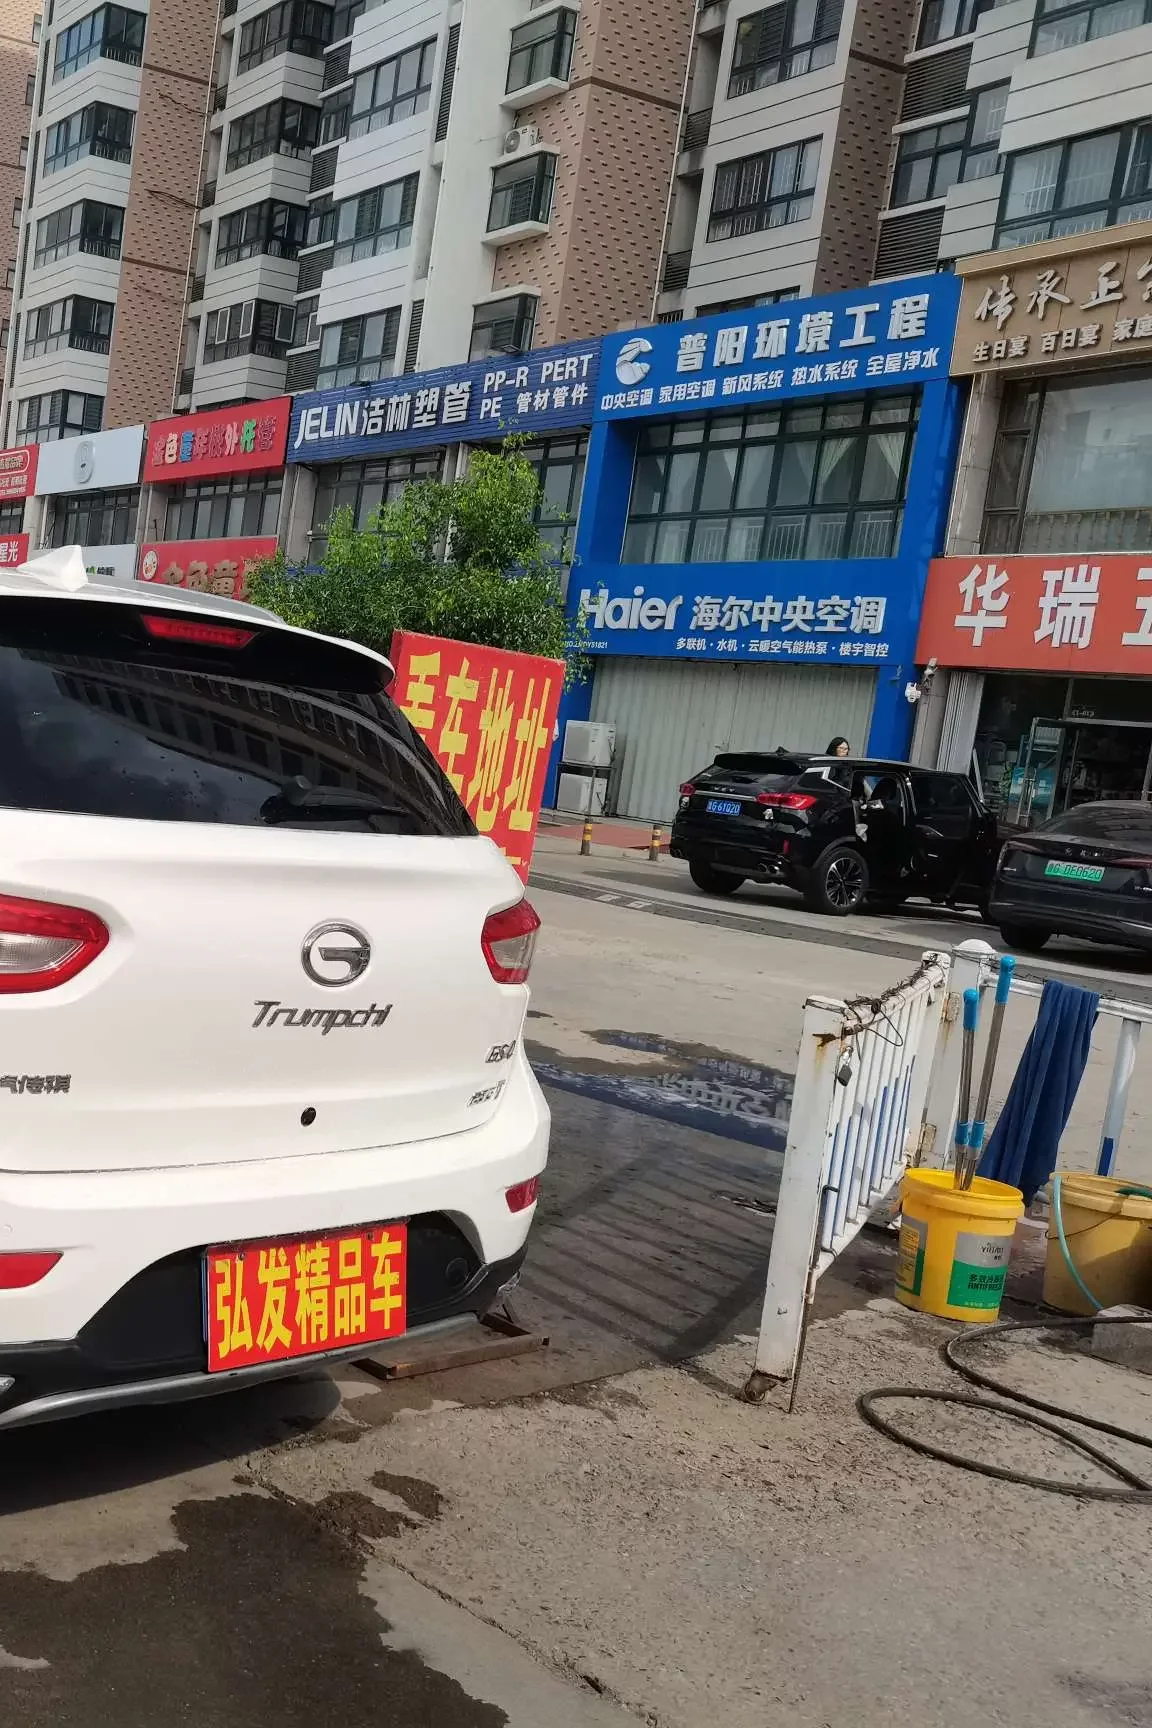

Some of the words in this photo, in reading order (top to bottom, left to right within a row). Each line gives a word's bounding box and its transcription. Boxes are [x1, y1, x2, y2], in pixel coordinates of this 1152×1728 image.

[676, 293, 930, 373] 普阳环境工程
[972, 335, 1028, 362] 生日宴
[1040, 323, 1101, 354] 百日宴
[483, 369, 529, 394] PP-R
[541, 354, 594, 384] PERT
[600, 387, 653, 411] 中央空调
[659, 378, 715, 402] 家用空调
[722, 369, 784, 396] 新风系统
[791, 359, 858, 387] 热水系统
[866, 347, 940, 376] 全屋净水
[294, 400, 360, 449] JELIN
[480, 396, 503, 420] PE
[516, 382, 589, 414] 管材管件
[580, 586, 683, 631] Haier
[690, 595, 887, 634] 海尔中央空调
[252, 1000, 393, 1036] Trumpchi
[215, 1232, 403, 1359] 弘发精品车
